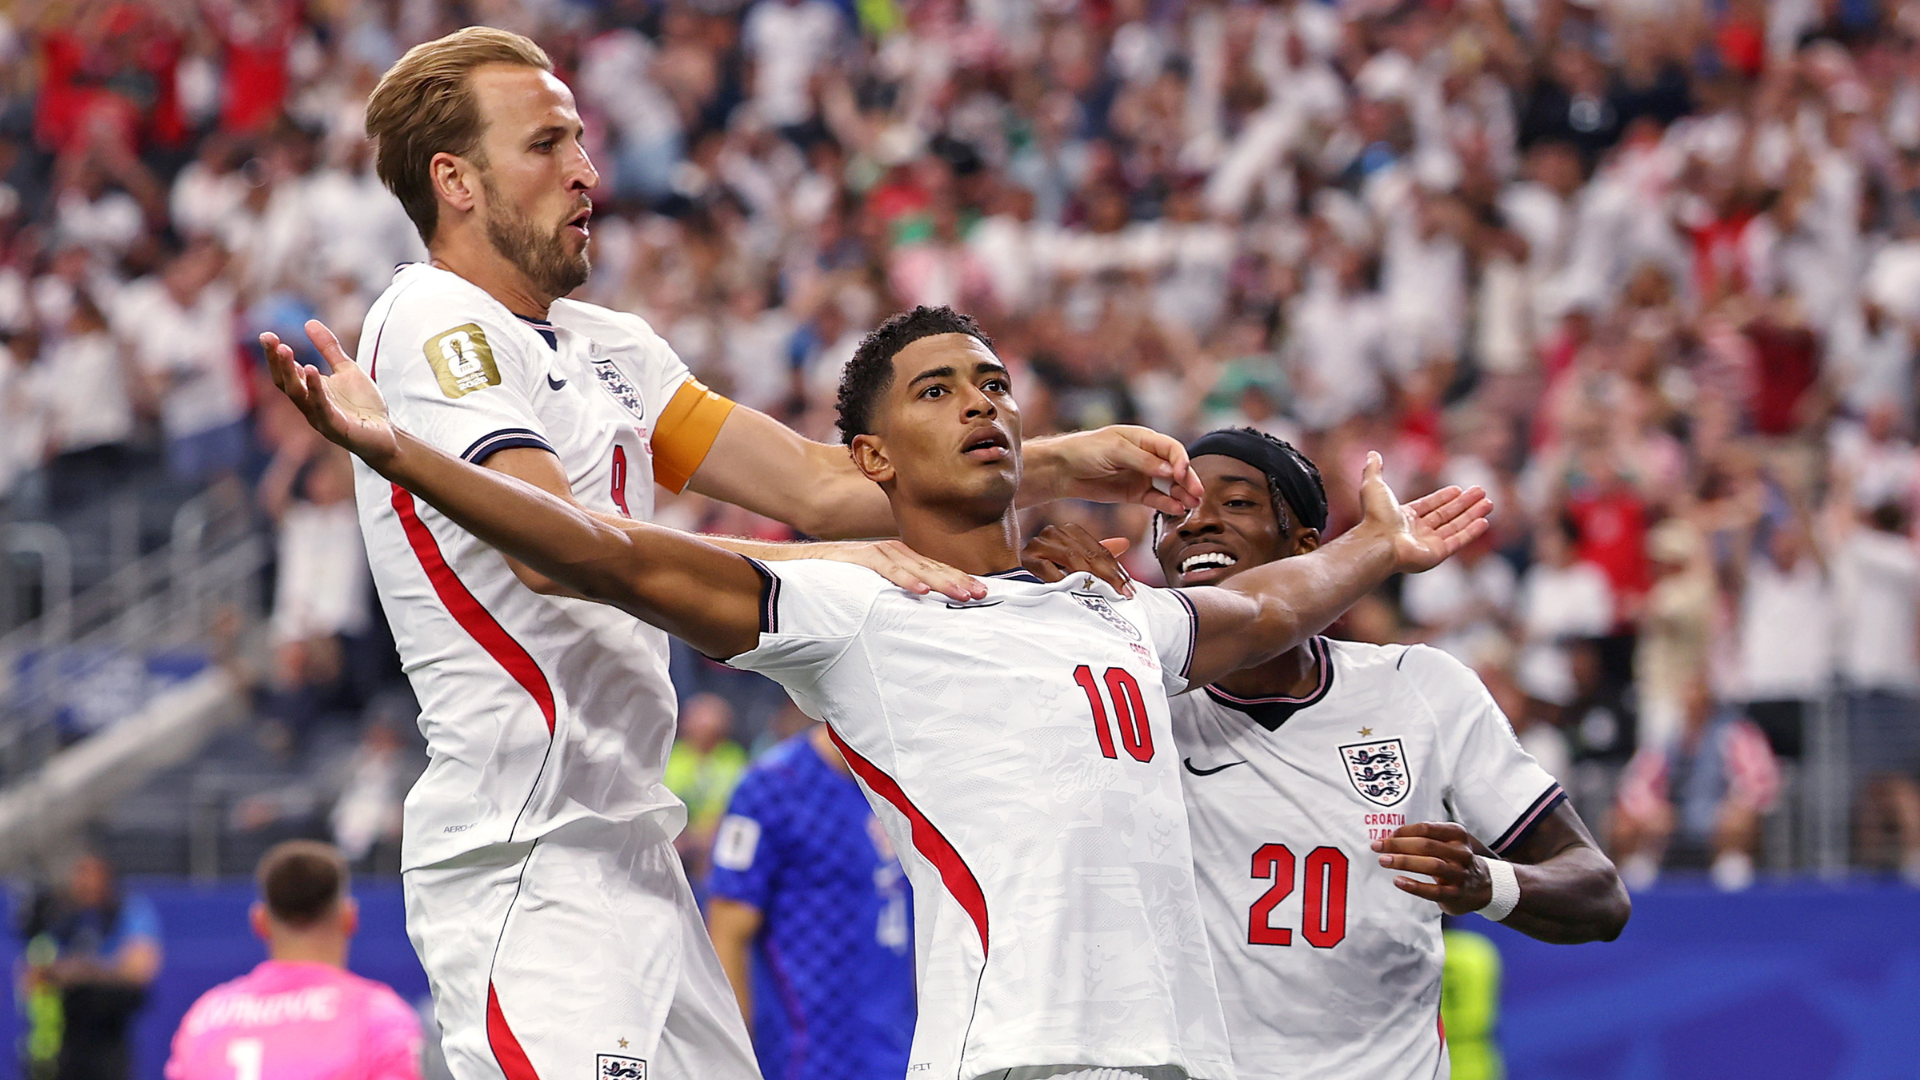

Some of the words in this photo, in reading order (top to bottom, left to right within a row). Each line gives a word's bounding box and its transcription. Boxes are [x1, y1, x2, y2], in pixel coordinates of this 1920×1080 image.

[611, 445, 632, 519] 9
[1073, 664, 1155, 763] 10
[1364, 813, 1406, 826] CROATIA
[1248, 843, 1349, 949] 20
